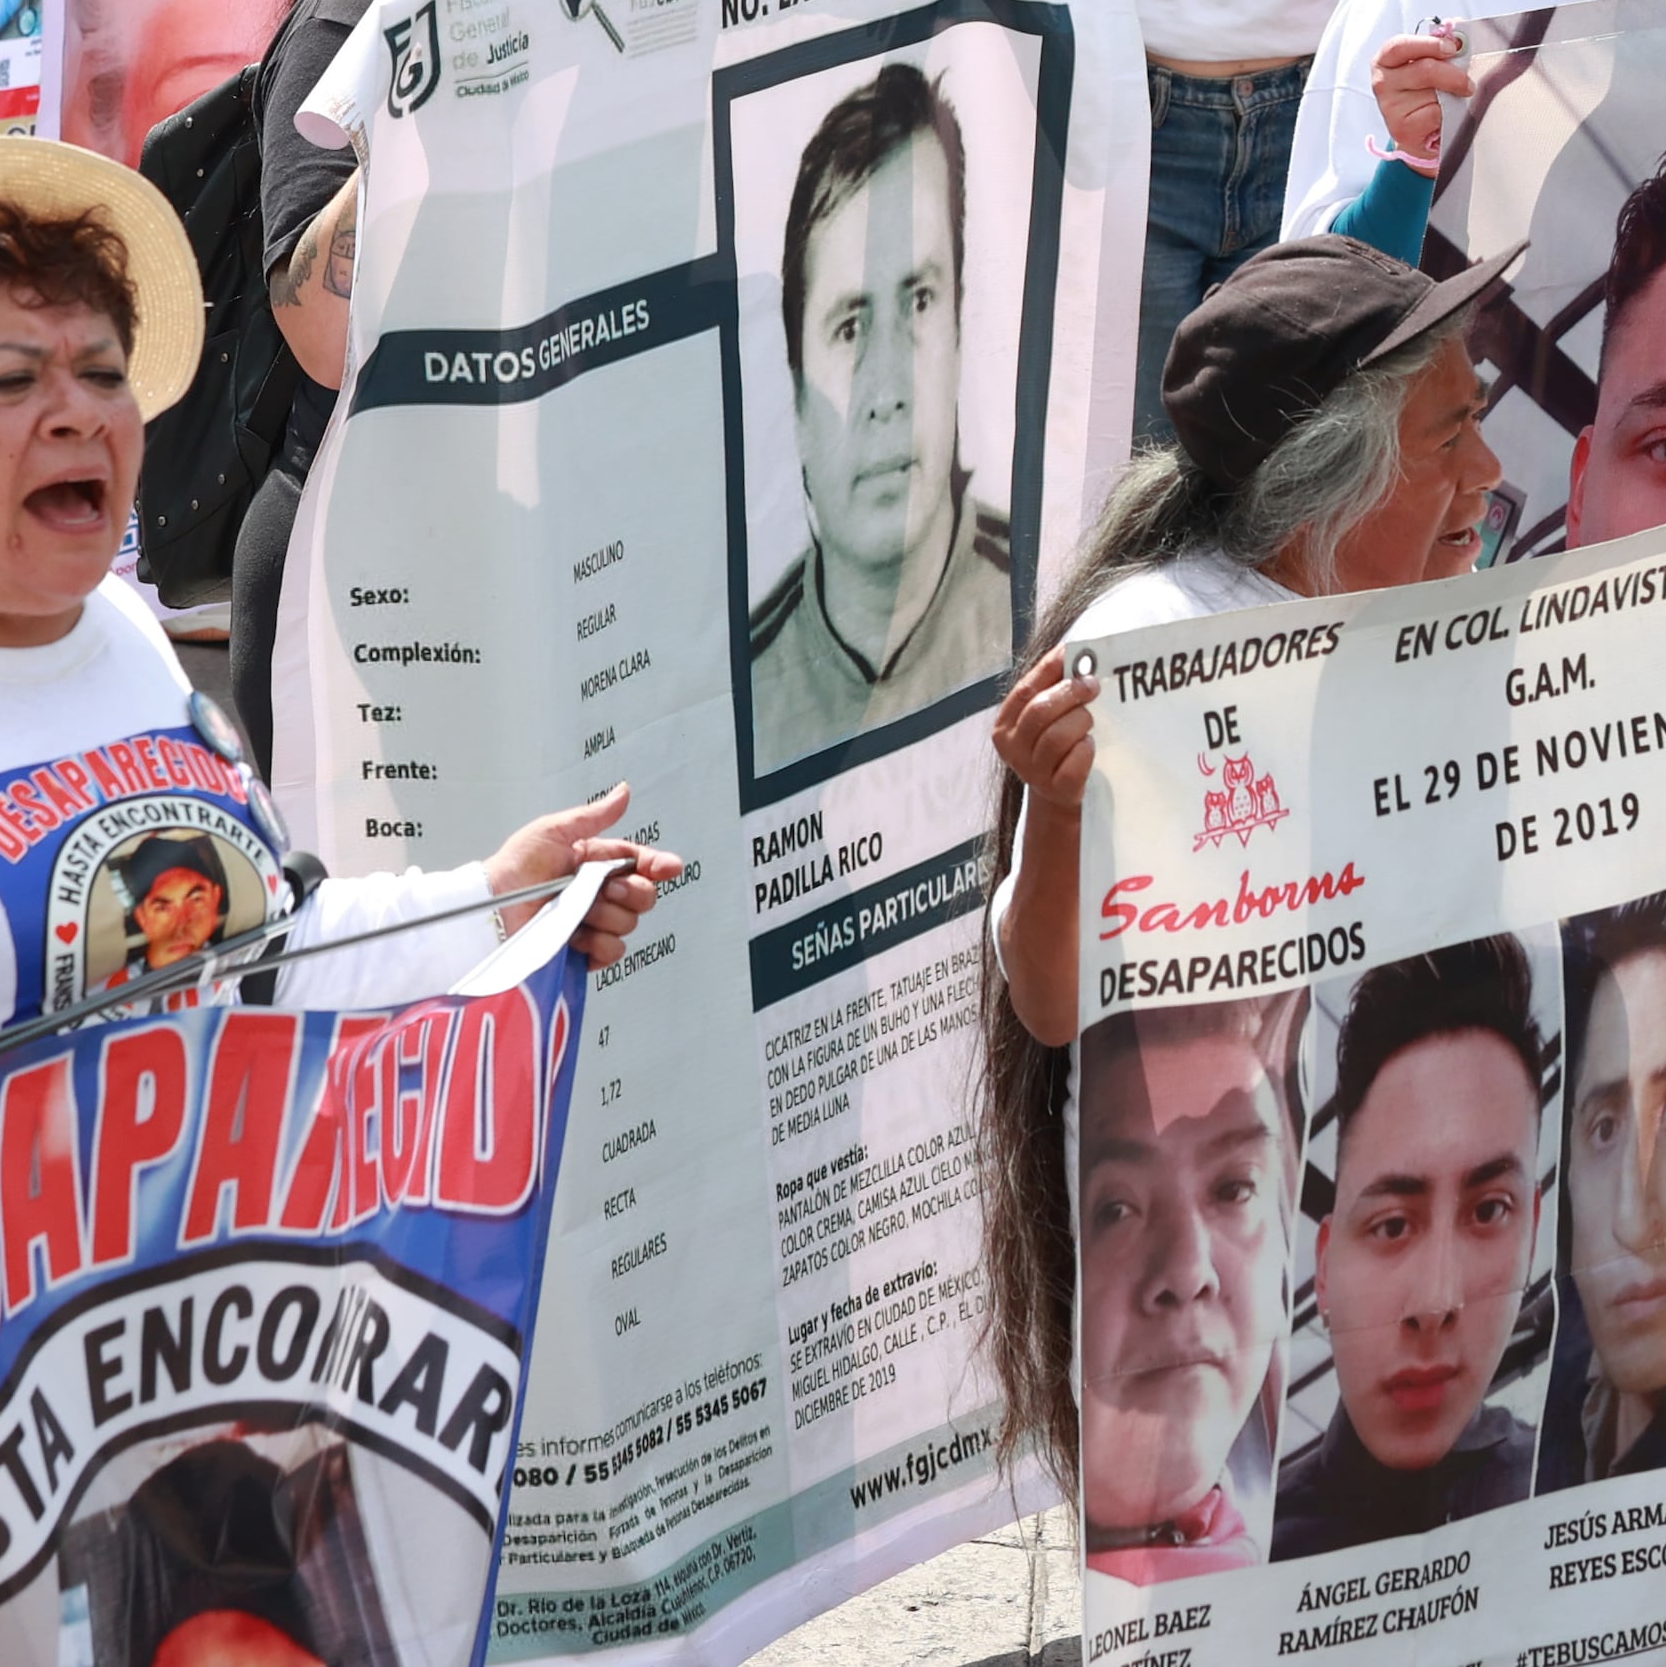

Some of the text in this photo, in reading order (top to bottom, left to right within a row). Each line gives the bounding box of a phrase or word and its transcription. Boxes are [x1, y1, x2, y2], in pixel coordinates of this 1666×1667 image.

[423, 298, 651, 386] DATOS GENERALES
[349, 584, 410, 607] Sexo:
[354, 638, 483, 667] Complexión:
[1113, 619, 1345, 705] TRABAJADORES
[1393, 620, 1441, 666] EN
[1445, 603, 1512, 654] COL.
[1504, 651, 1597, 709] G.A.M.
[1203, 704, 1243, 751] DE
[1373, 775, 1412, 818] EL
[1423, 755, 1462, 803] 29
[1476, 744, 1522, 795] DE
[58, 801, 265, 907] HASTA ENCONTRARTE
[752, 810, 824, 868] RAMON
[1494, 790, 1643, 863] DE 2019
[755, 831, 884, 914] PADILLA RICO
[1099, 860, 1366, 941] Sanborns
[1099, 919, 1367, 1009] DESAPARECIDOS
[1543, 1511, 1608, 1551] JESÚS
[1296, 1550, 1472, 1615] ÁNGEL GERARDO
[1548, 1553, 1619, 1590] REYES
[1277, 1585, 1481, 1656] RAMÍREZ CHAUFÓN
